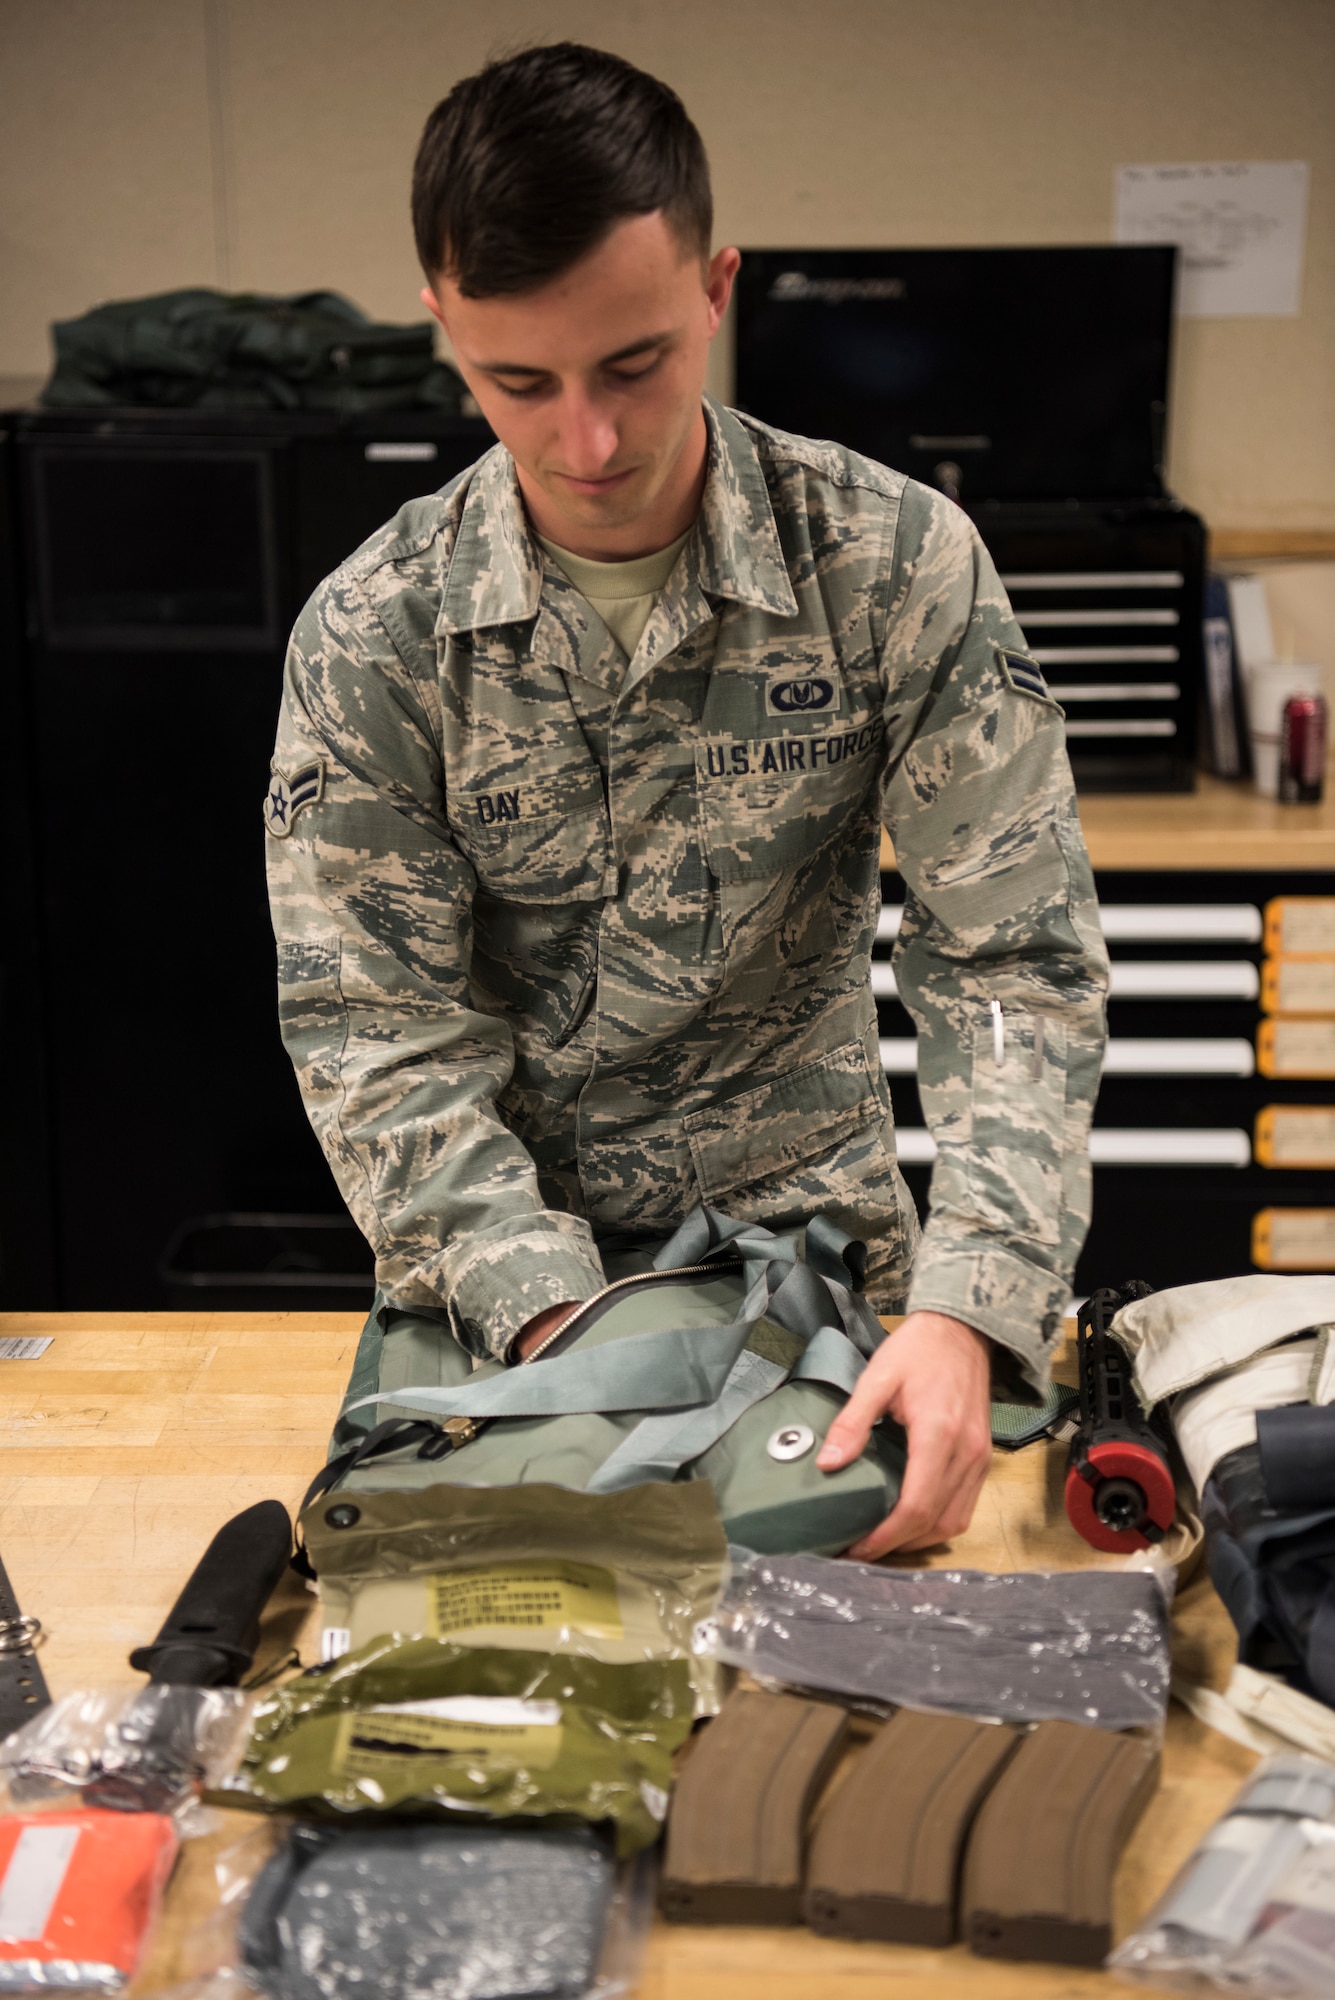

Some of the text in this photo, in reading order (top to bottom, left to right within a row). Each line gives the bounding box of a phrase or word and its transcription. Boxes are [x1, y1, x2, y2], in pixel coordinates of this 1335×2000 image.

[707, 716, 885, 777] U.S. AIR FORCE
[476, 789, 519, 824] DAY
